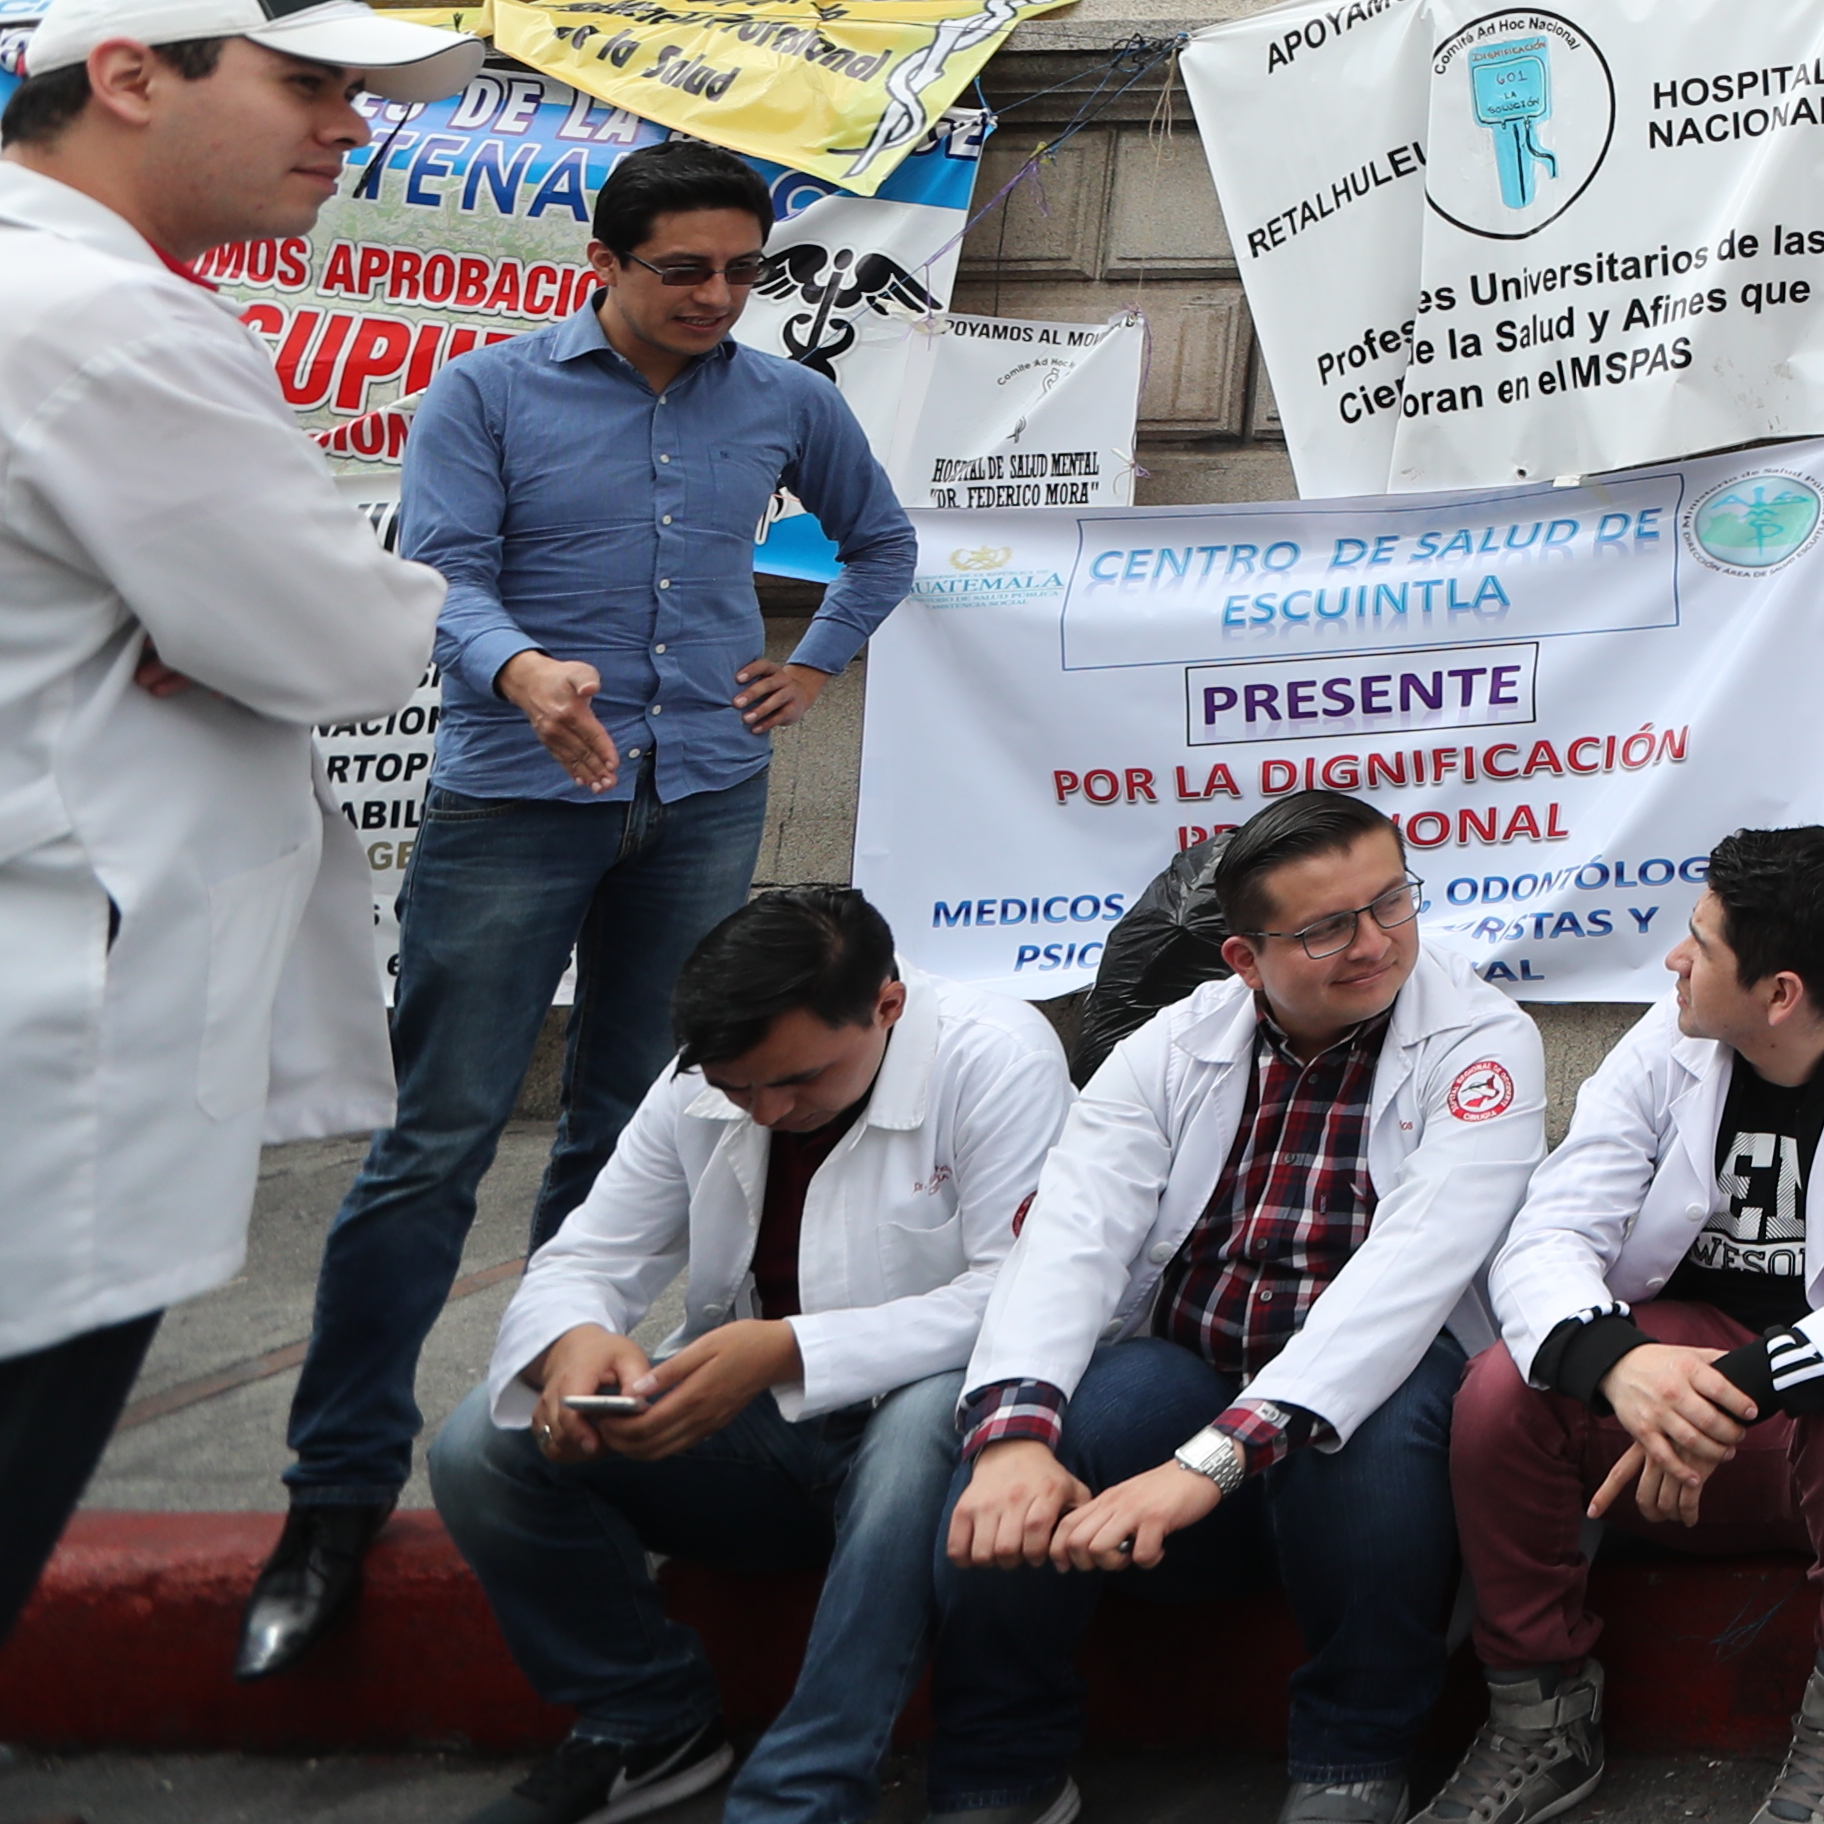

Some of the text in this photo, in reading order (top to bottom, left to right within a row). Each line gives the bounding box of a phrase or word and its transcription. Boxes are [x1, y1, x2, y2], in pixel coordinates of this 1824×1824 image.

[1477, 17, 1581, 50] Ad Hoc Nacional
[1496, 70, 1528, 85] 601
[1469, 243, 1709, 307] Universitarios
[1715, 229, 1759, 261] de
[1038, 329, 1061, 345] AL
[1448, 278, 1811, 362] la Salud y Afines que
[1497, 335, 1693, 405] en el MSPAS
[988, 451, 1099, 479] DE SALUD MENTAL
[967, 485, 1041, 509] FEDERICO
[1088, 506, 1664, 581] CENTRO DE SALUD DE
[1222, 574, 1511, 627] ESCUINTLA
[1202, 664, 1522, 726] PRESENTE
[1053, 723, 1691, 804] POR LA DIGNIFICACIÓN
[932, 893, 1125, 928] MEDICOS
[1627, 905, 1660, 935] Y
